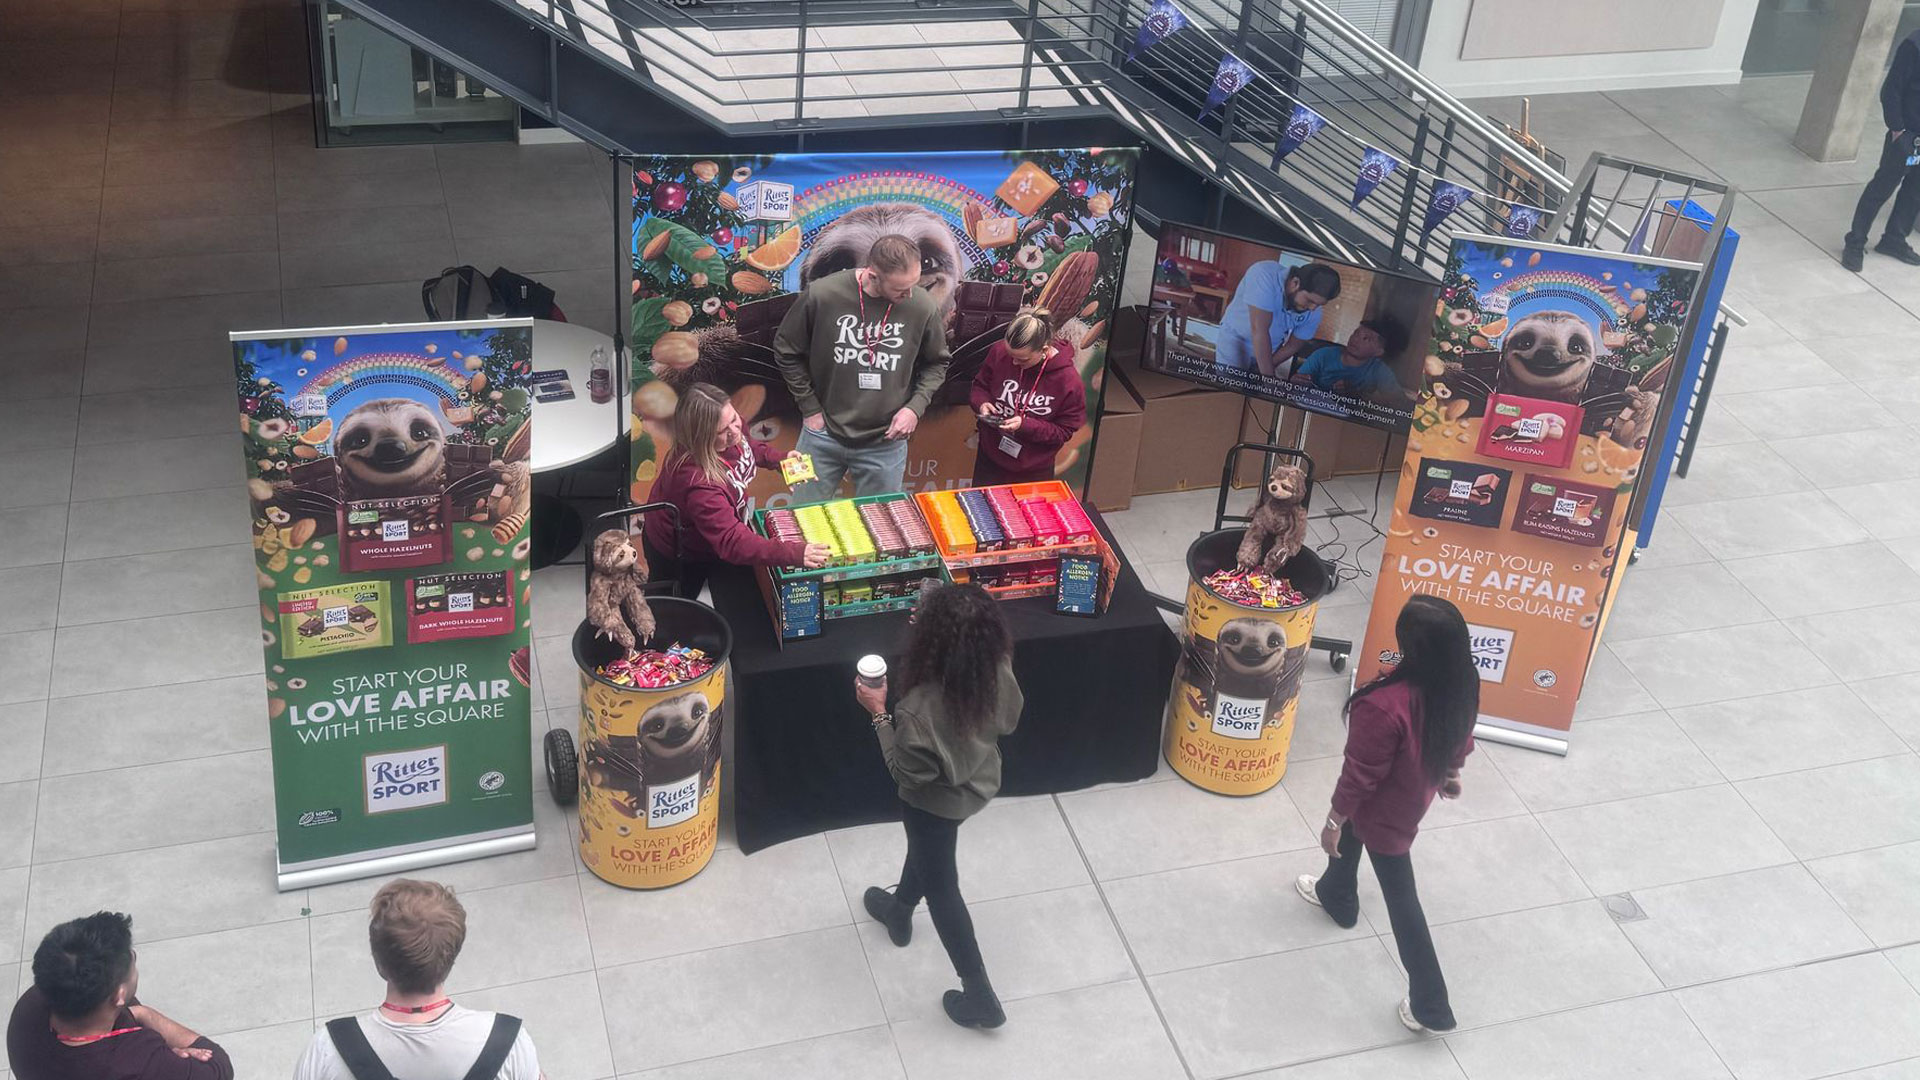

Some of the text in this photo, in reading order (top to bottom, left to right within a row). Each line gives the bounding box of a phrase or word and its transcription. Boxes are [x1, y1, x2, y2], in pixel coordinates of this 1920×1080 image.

[763, 202, 788, 211] SPORT
[834, 314, 905, 349] Ritter
[834, 346, 902, 372] SPORT
[996, 379, 1055, 416] Ritter
[1168, 351, 1190, 362] That's
[1192, 358, 1210, 371] why
[1225, 366, 1247, 378] focus
[1249, 372, 1260, 380] on
[1261, 375, 1293, 391] training
[1294, 384, 1309, 392] our
[1309, 388, 1357, 405] employees
[1358, 399, 1394, 415] in-house
[1395, 408, 1413, 419] and
[1178, 366, 1398, 425] providing opportunities for professional development.
[1504, 445, 1545, 456] MARZIPAN
[908, 459, 938, 477] UR
[378, 498, 437, 508] SELECTION
[360, 543, 433, 555] WHOLE HAZELNUTS
[1438, 543, 1555, 577] START YOUR
[444, 573, 502, 582] SELECTION
[1398, 555, 1586, 606] LOVE AFFAIR
[292, 584, 376, 600] NUT SELECTION
[1400, 577, 1576, 623] WITH THE SQUARE
[438, 619, 464, 627] WHOLE
[464, 617, 503, 625] HAZELNUTS
[320, 632, 355, 642] PISTACHIO
[1471, 655, 1503, 670] ORT
[332, 663, 468, 695] START YOUR
[289, 678, 512, 726] LOVE AFFAIR
[1220, 701, 1261, 720] Ritter
[296, 703, 505, 745] WITH THE SQUARE
[1217, 717, 1260, 731] SPORT
[1179, 736, 1281, 771] LOVE AFFAIR
[1198, 738, 1267, 759] START YOUR
[372, 756, 441, 786] Ritter
[1180, 751, 1275, 783] WITH THE SQUARE
[372, 778, 441, 800] SPORT
[652, 782, 696, 808] Ritter
[652, 798, 696, 819] SPORT
[633, 820, 707, 849] START YOUR
[610, 845, 661, 862] LOVE
[613, 841, 711, 875] WITH THE SQUA
